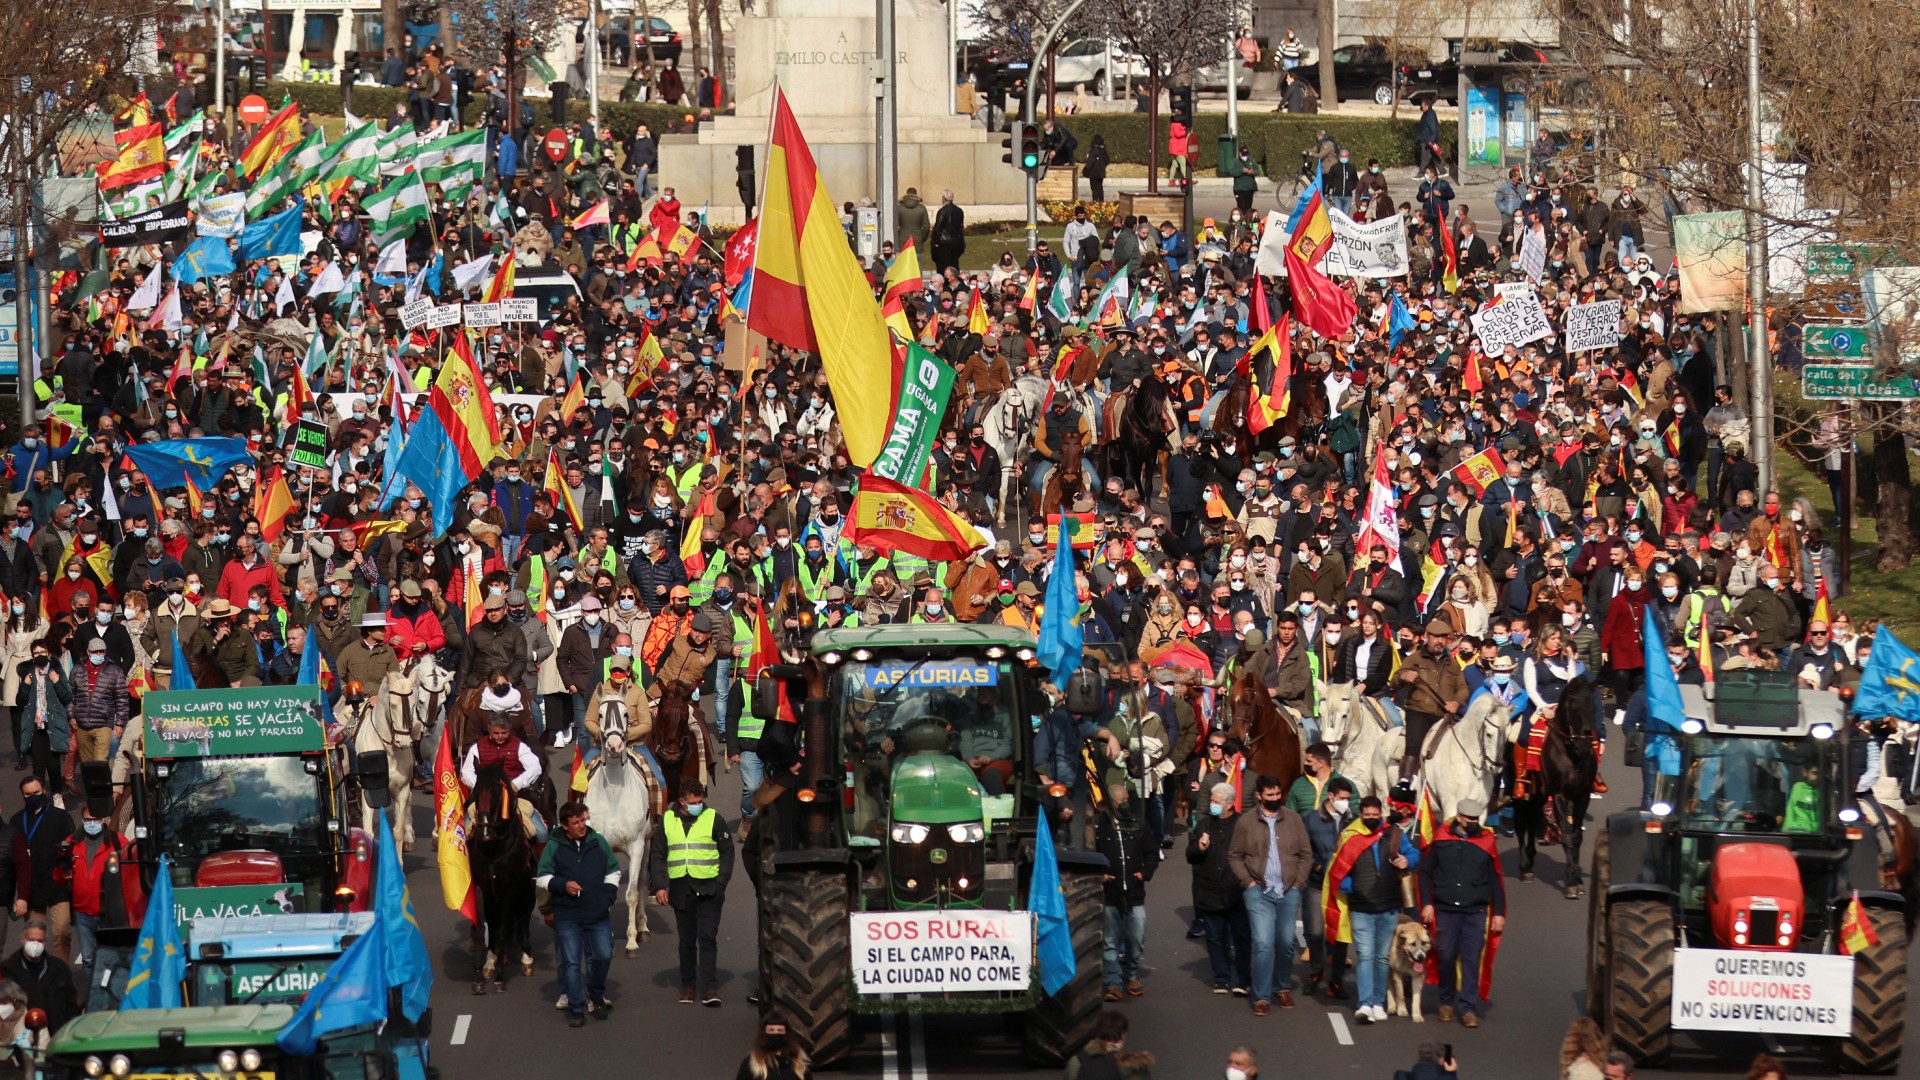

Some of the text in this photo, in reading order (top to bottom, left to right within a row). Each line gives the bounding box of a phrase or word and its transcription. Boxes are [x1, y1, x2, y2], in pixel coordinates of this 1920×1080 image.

[837, 31, 848, 43] A
[775, 51, 908, 65] EMILIO CASTER
[103, 224, 136, 236] CALIDAD
[404, 300, 426, 313] HARTOS
[430, 311, 458, 319] DESTRUIR
[1481, 298, 1527, 323] CRIAR
[1570, 301, 1620, 322] SOY CRIADOR
[1478, 302, 1538, 338] PERROS DE
[1523, 313, 1539, 326] ES
[1571, 312, 1619, 331] DE PERROS
[1486, 320, 1549, 354] CONSERVAR
[1571, 332, 1618, 350] ORGULLOSO
[1807, 370, 1855, 380] calle del
[906, 382, 937, 414] UGAMA
[1807, 383, 1862, 395] General
[299, 427, 325, 448] SE VENDE
[876, 408, 921, 480] GAMA
[873, 668, 990, 685] ASTURIAS
[161, 698, 302, 713] SIN CAMPO NO HAY VIDA
[161, 708, 304, 729] ASTURIAS SE VACÍA
[162, 726, 304, 741] SIN VACAS NO HAY PARAISO
[211, 903, 263, 919] VACA
[867, 919, 1015, 941] SOS RURAL
[867, 945, 1015, 963] SI EL CAMPO PARA,
[863, 966, 1021, 984] LA CIUDAD NO COME
[1715, 957, 1806, 977] QUEREMOS
[237, 972, 326, 993] ASTURIA
[1707, 980, 1812, 1000] SOLUCIONES
[1680, 1001, 1837, 1024] NO SUBVENCIONES
